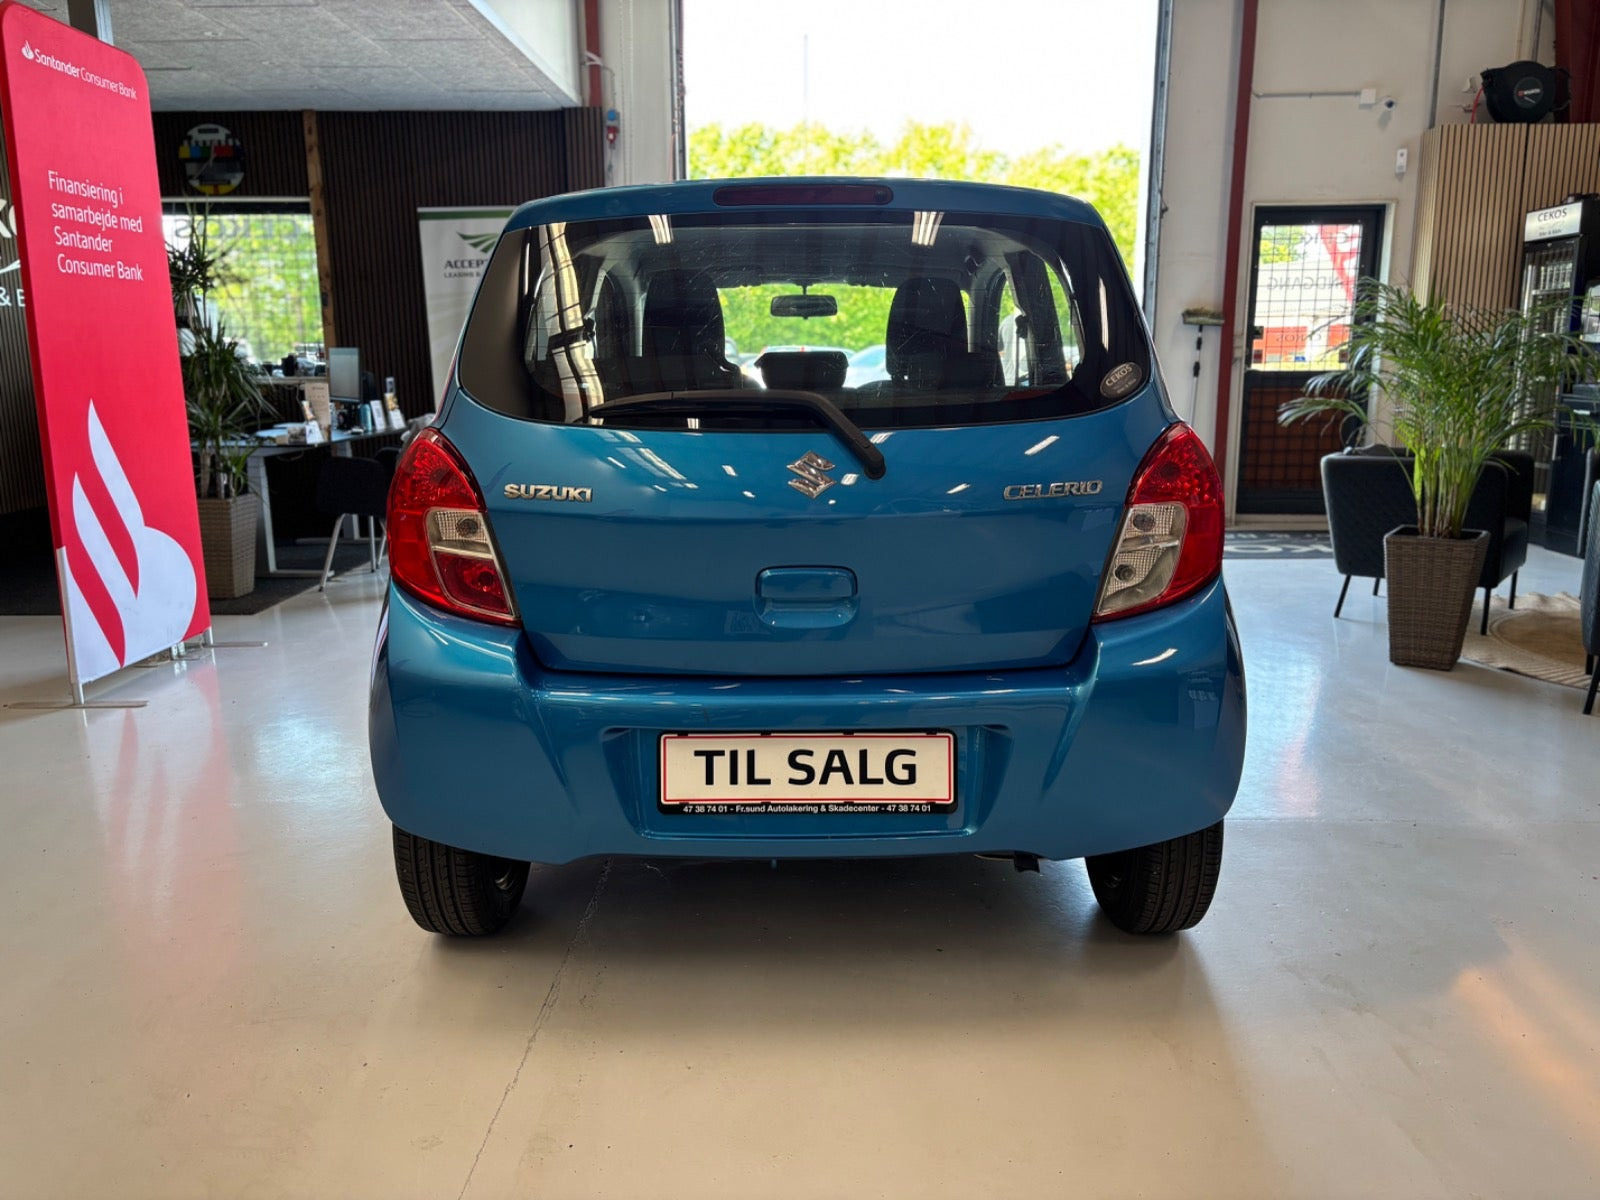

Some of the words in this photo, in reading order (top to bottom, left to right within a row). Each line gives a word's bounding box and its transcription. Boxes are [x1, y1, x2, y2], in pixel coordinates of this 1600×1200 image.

[34, 48, 80, 78] Santander
[80, 67, 119, 93] Consumer
[118, 82, 137, 100] Bank
[48, 170, 118, 208] Finansiering
[119, 187, 124, 205] i
[51, 203, 118, 231] samarbejde
[119, 216, 143, 233] med
[1537, 208, 1567, 222] CEKOS
[54, 226, 112, 253] Santander
[57, 253, 115, 278] Consumer
[116, 261, 144, 281] Bank
[444, 259, 488, 269] ACCEP
[1105, 364, 1133, 387] CEKOS
[503, 483, 593, 503] SUZUKI
[1003, 480, 1103, 501] CELERIO
[694, 749, 771, 786] TIL
[787, 749, 917, 786] SALG
[683, 804, 693, 813] 47
[695, 804, 705, 813] 38
[707, 804, 717, 813] 74
[718, 804, 728, 813] 01
[820, 804, 827, 813] &
[828, 804, 879, 812] Skadecenter
[886, 804, 896, 812] 47
[898, 804, 908, 812] 38
[910, 804, 920, 812] 74
[922, 804, 931, 812] 01
